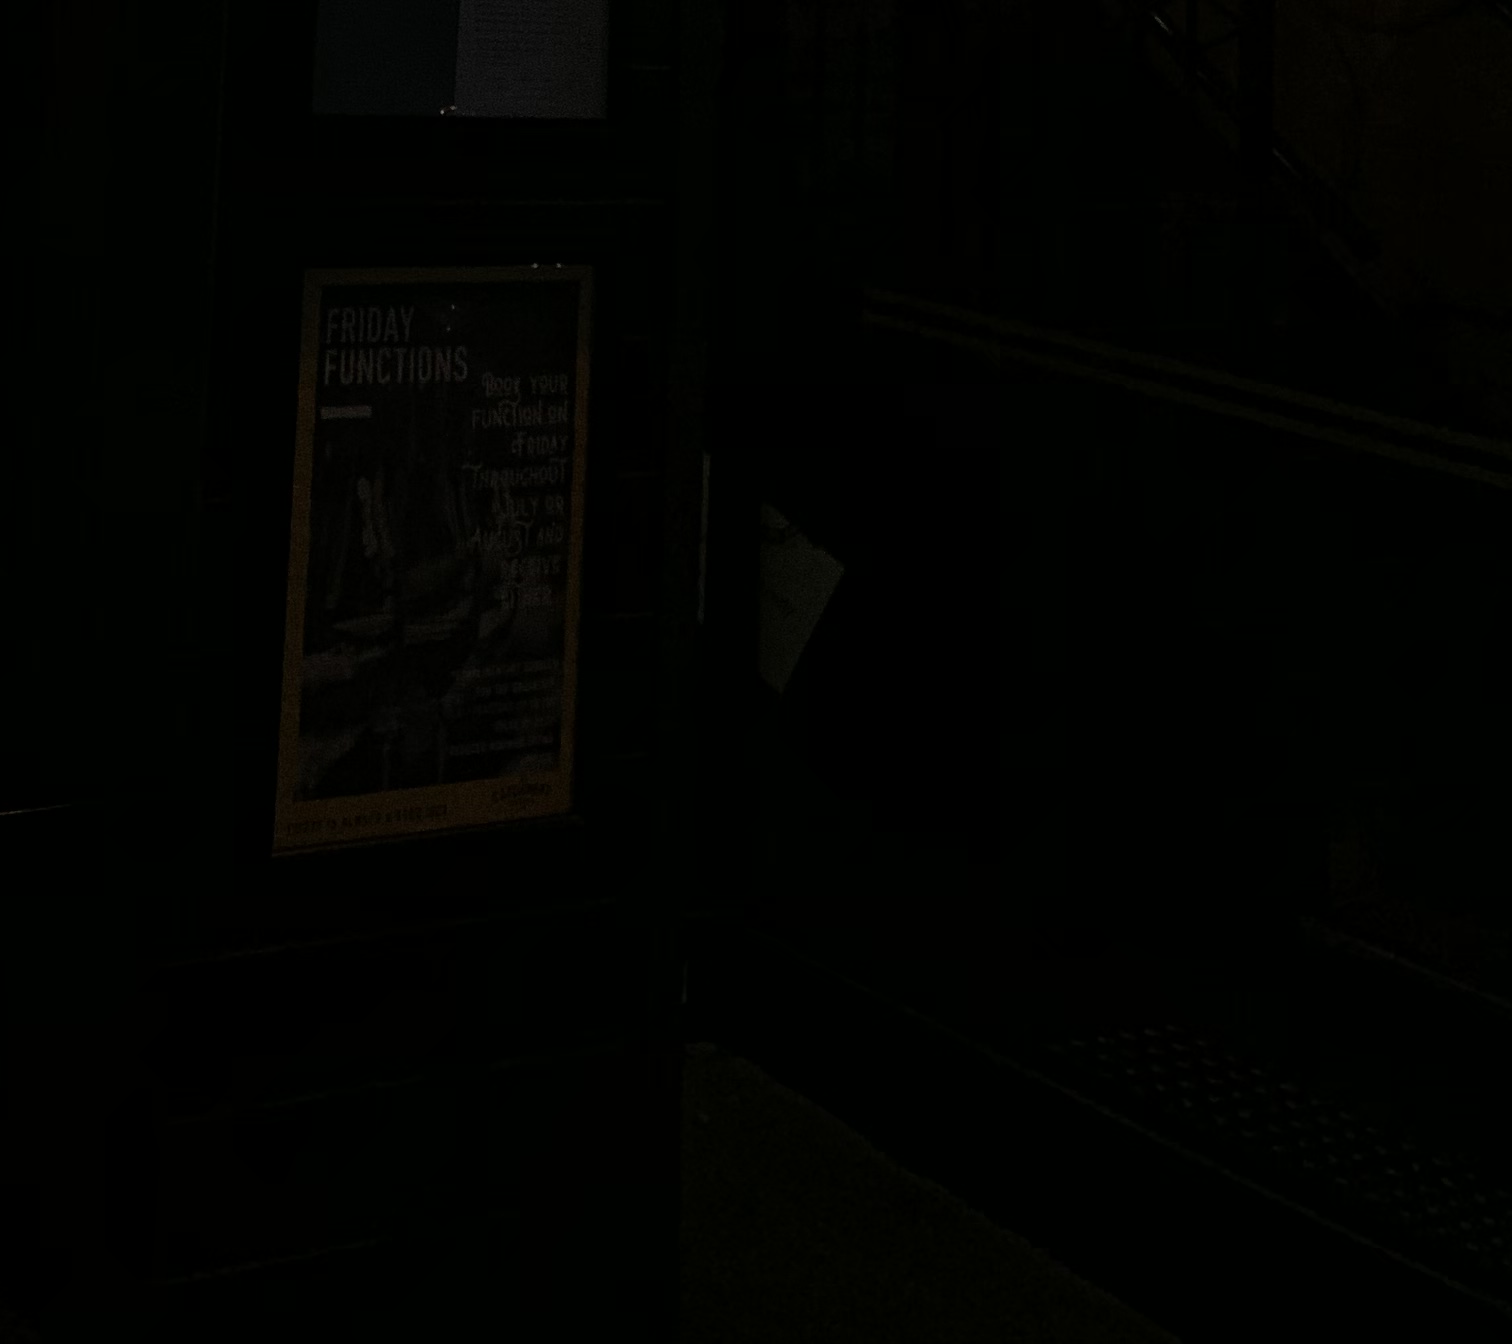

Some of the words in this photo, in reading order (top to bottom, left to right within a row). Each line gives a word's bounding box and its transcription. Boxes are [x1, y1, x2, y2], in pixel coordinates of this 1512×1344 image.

[326, 304, 416, 344] FRIDAY
[324, 345, 469, 385] FUNCTIONS
[529, 372, 570, 396] YOUR
[472, 399, 543, 429] FUNCTION
